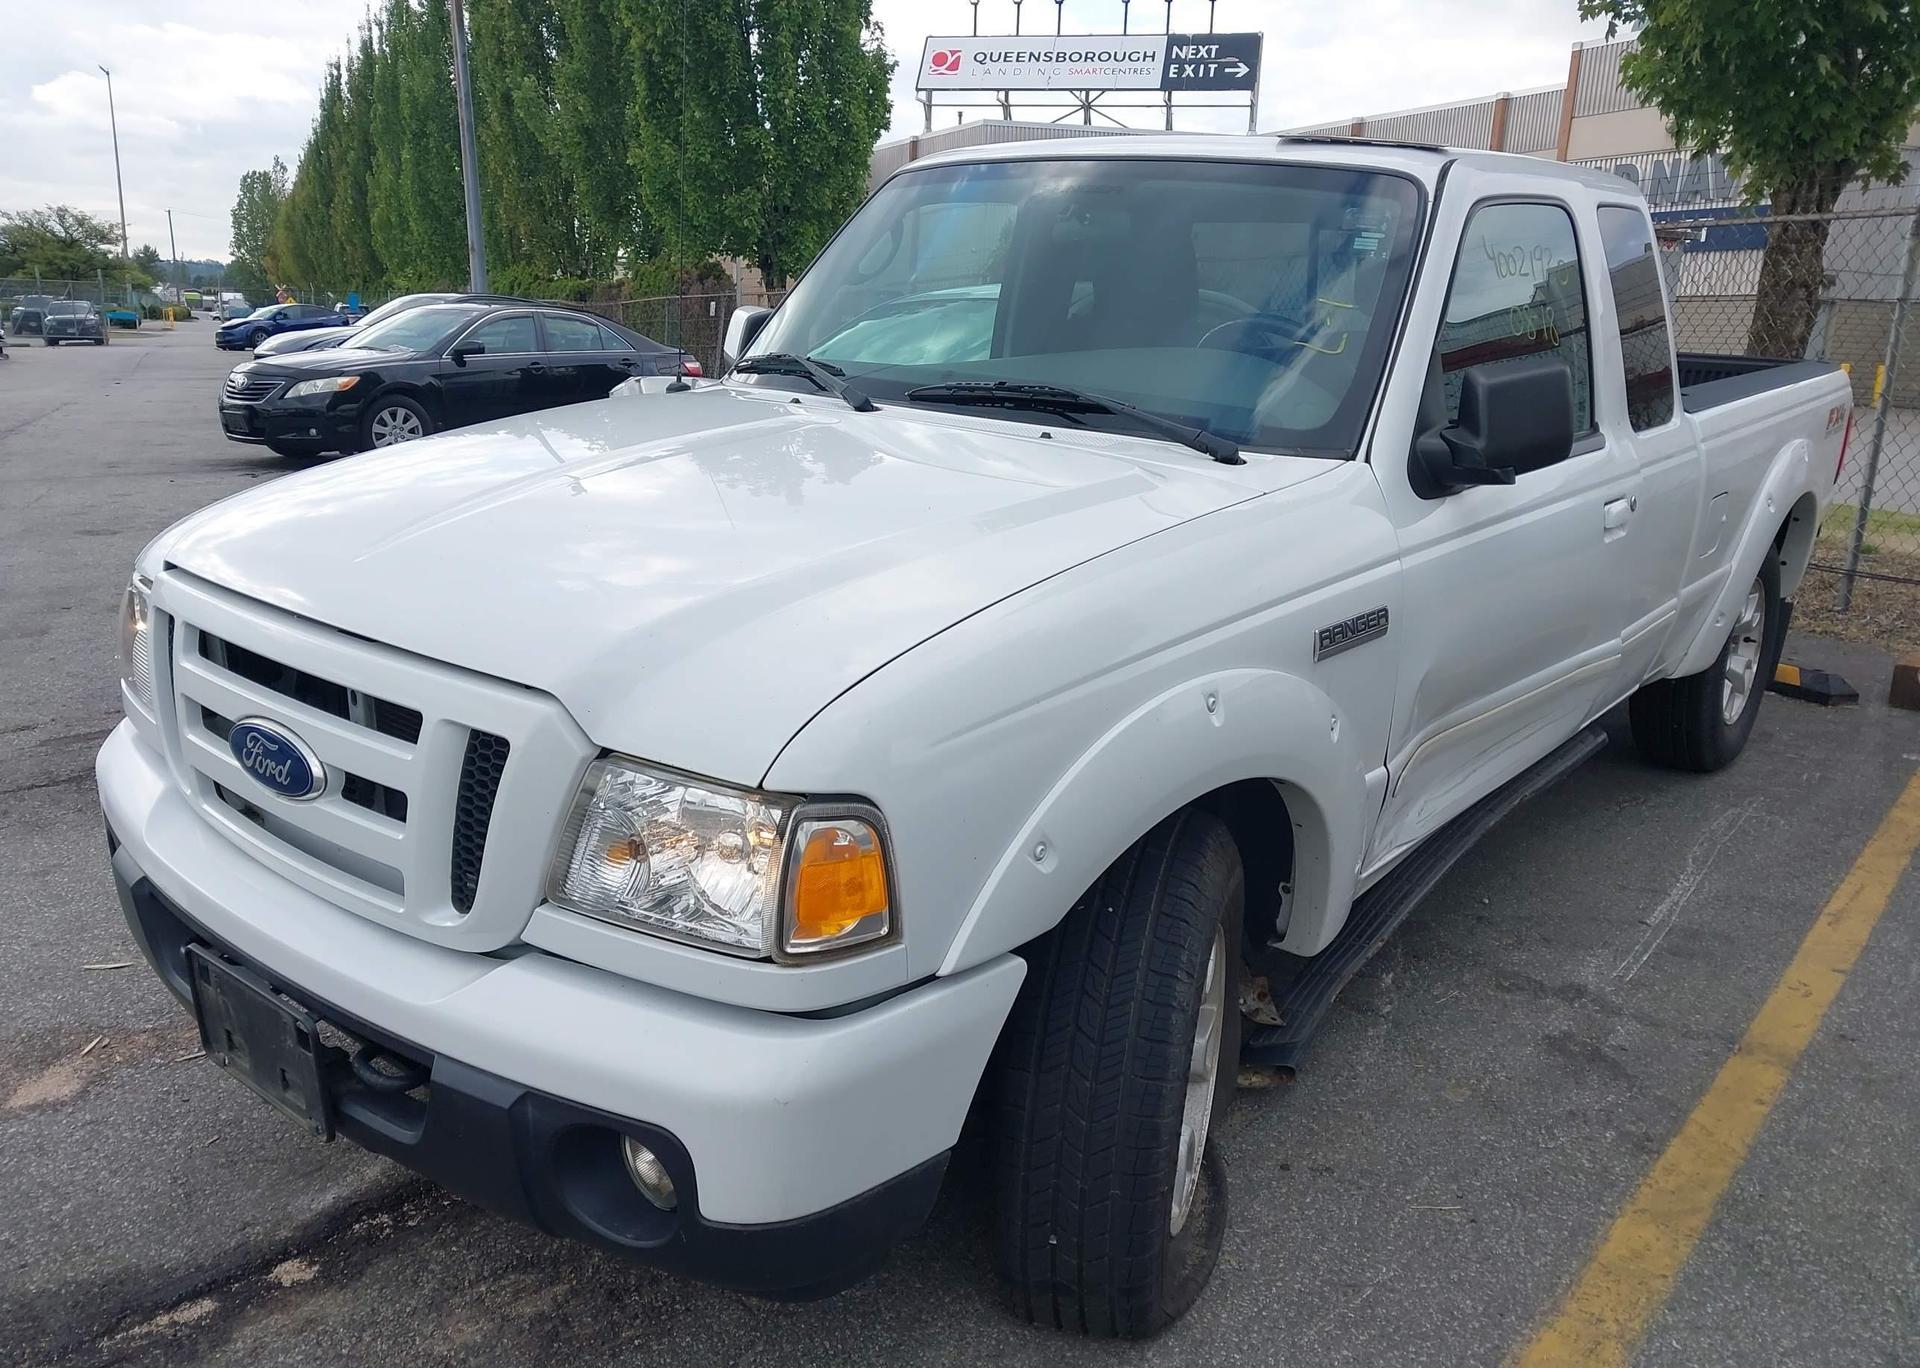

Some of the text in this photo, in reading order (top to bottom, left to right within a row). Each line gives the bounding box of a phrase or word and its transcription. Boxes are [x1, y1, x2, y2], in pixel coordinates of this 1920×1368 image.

[973, 50, 1157, 64] QUEENSBOROUGH
[1171, 44, 1220, 59] NEXT
[971, 66, 1153, 77] LANDING SMARTCENTRES
[1169, 63, 1219, 78] EXIT
[1319, 607, 1390, 650] RANGER
[242, 731, 291, 785] Ford
